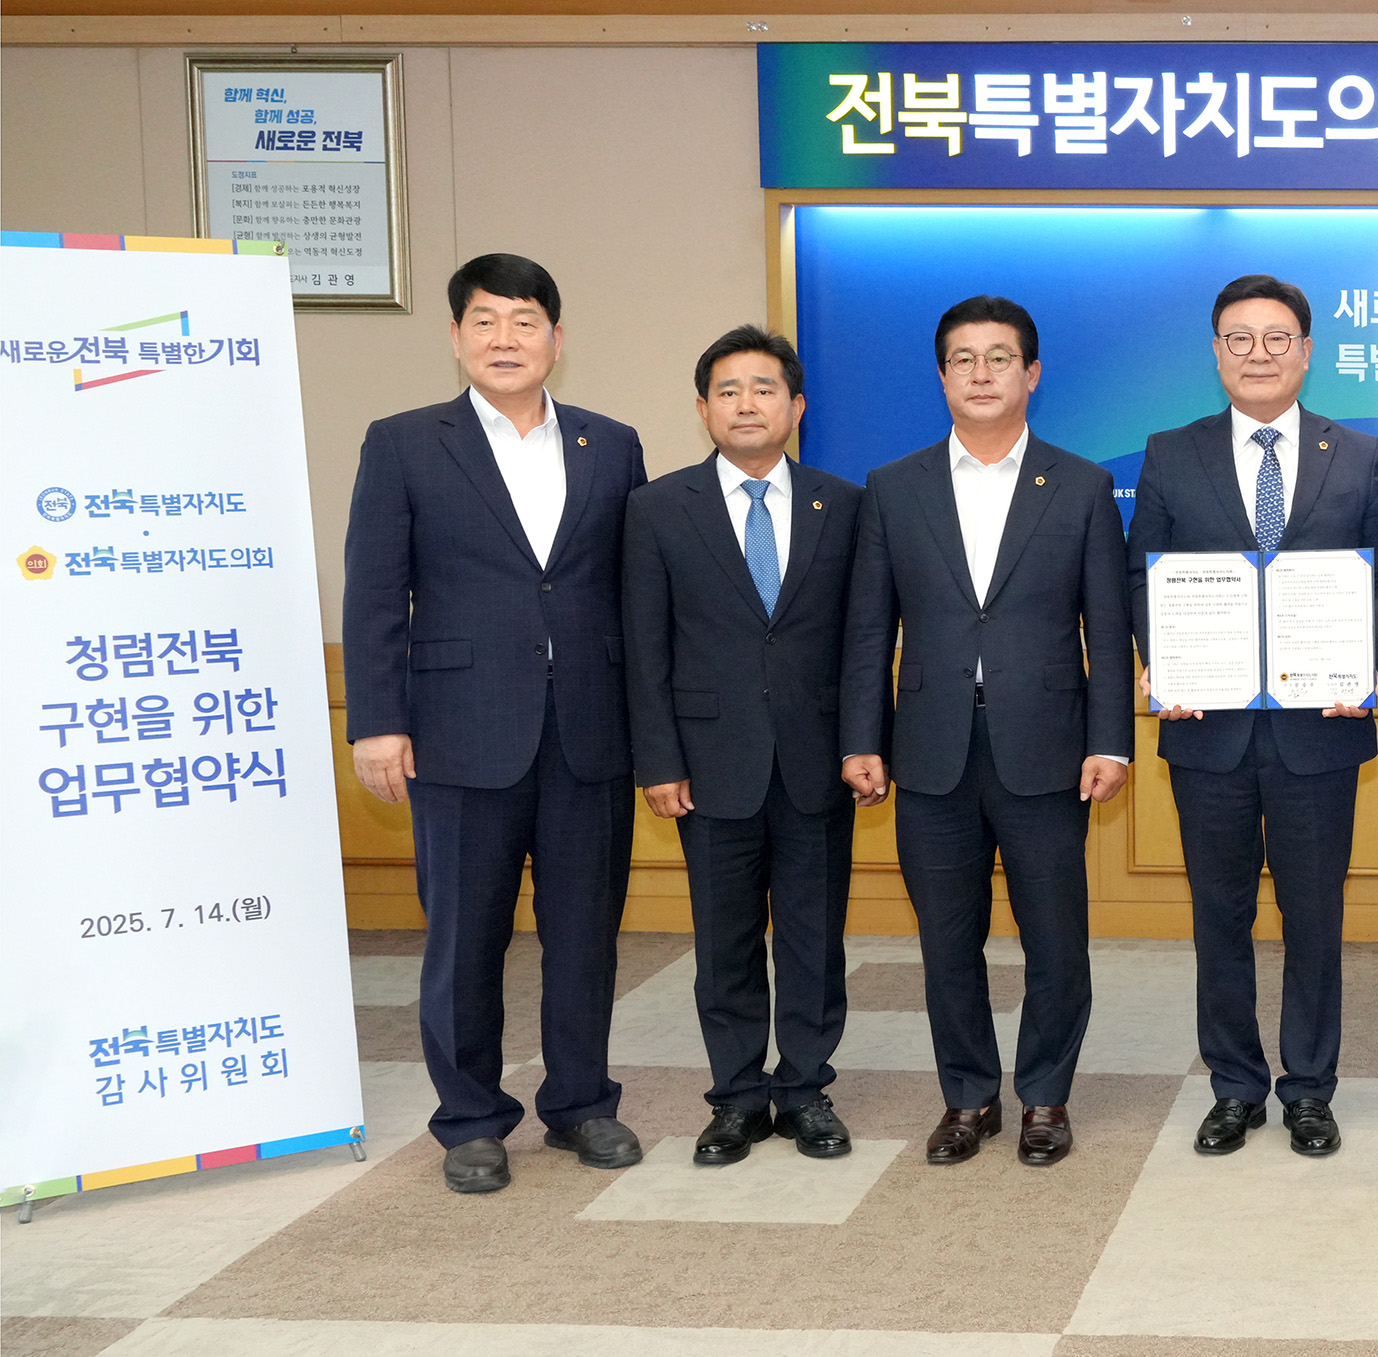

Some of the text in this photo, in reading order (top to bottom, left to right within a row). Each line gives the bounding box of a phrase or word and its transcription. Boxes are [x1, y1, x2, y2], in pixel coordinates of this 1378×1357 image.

[223, 87, 288, 105] 함께 혁신,
[254, 108, 318, 126] 함께 성공,
[255, 130, 363, 152] 새로운 전북
[231, 171, 258, 180] 도정지표
[328, 184, 361, 194] 혁신성장
[85, 489, 246, 517] 전북특별자치도
[27, 560, 47, 569] 의회
[65, 546, 273, 575] 전북특별자치도의회
[66, 629, 242, 681] 청렴전북
[40, 688, 278, 748] 구현을 위한
[39, 749, 286, 818] 업무협약식
[81, 896, 270, 938] 2025. 7. 14.(월)
[89, 1014, 287, 1068] 전북특별자치도
